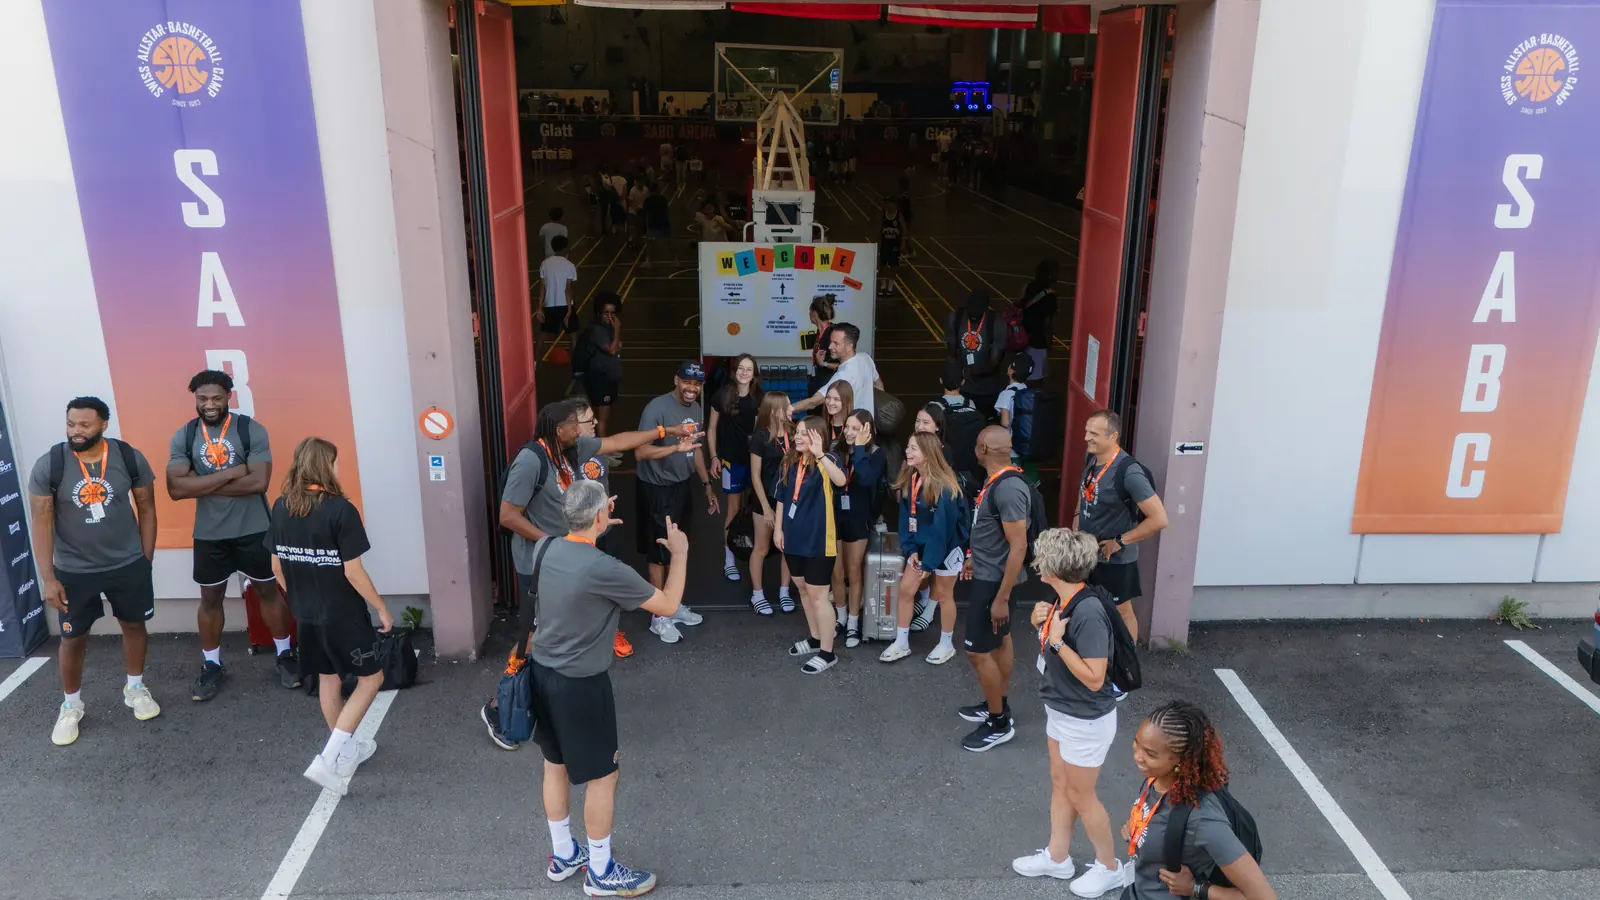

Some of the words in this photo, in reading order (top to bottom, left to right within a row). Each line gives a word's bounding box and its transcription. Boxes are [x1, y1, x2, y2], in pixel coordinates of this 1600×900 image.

[137, 23, 166, 62] ALLSTAR
[1503, 35, 1537, 72] ALLSTAR
[138, 65, 164, 98] SWISS
[207, 67, 225, 98] CAMP
[1500, 75, 1517, 106] SWISS
[1555, 76, 1578, 106] CAMP
[539, 122, 575, 137] Glatt
[721, 250, 847, 269] WELCOME
[1446, 153, 1544, 499] SABC
